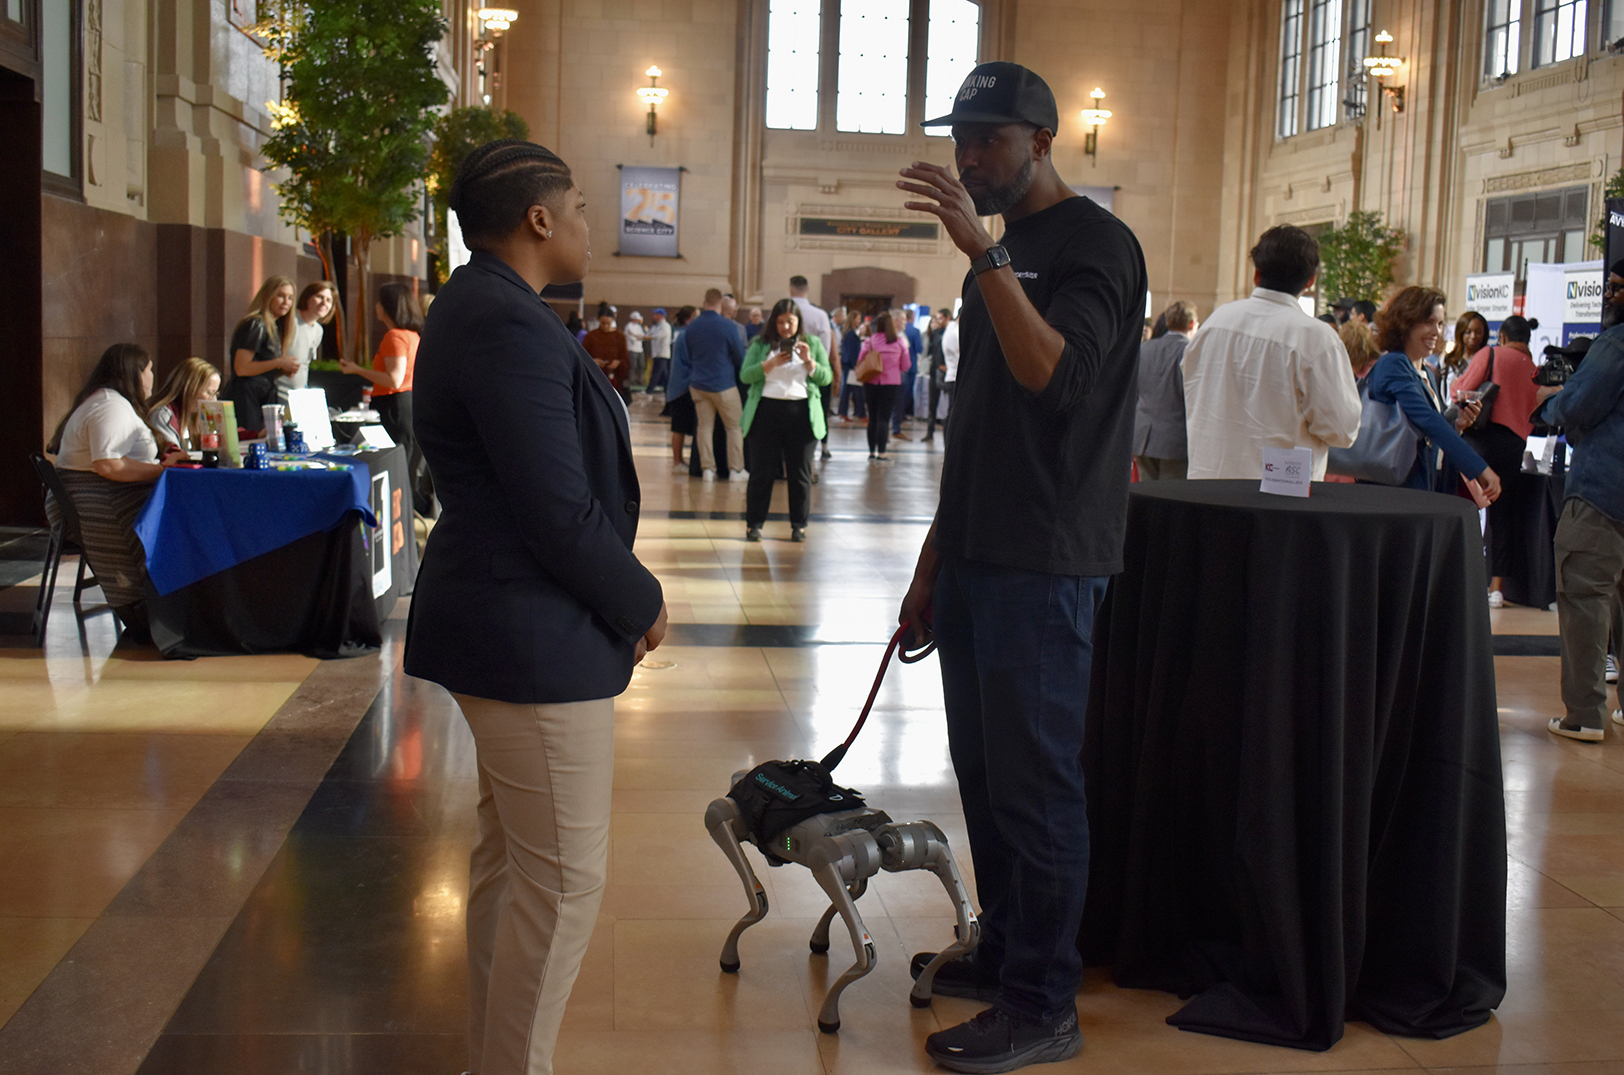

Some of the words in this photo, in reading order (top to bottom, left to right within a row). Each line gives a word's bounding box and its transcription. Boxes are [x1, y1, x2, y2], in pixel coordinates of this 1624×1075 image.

[960, 88, 978, 102] CAP
[625, 182, 677, 191] CELEBRATING
[624, 187, 676, 225] 25
[626, 227, 655, 235] SCIENCE
[656, 228, 675, 236] CITY
[836, 226, 858, 235] CITY
[1567, 281, 1603, 299] Nvisio
[755, 772, 779, 790] Service
[775, 786, 801, 800] Animal
